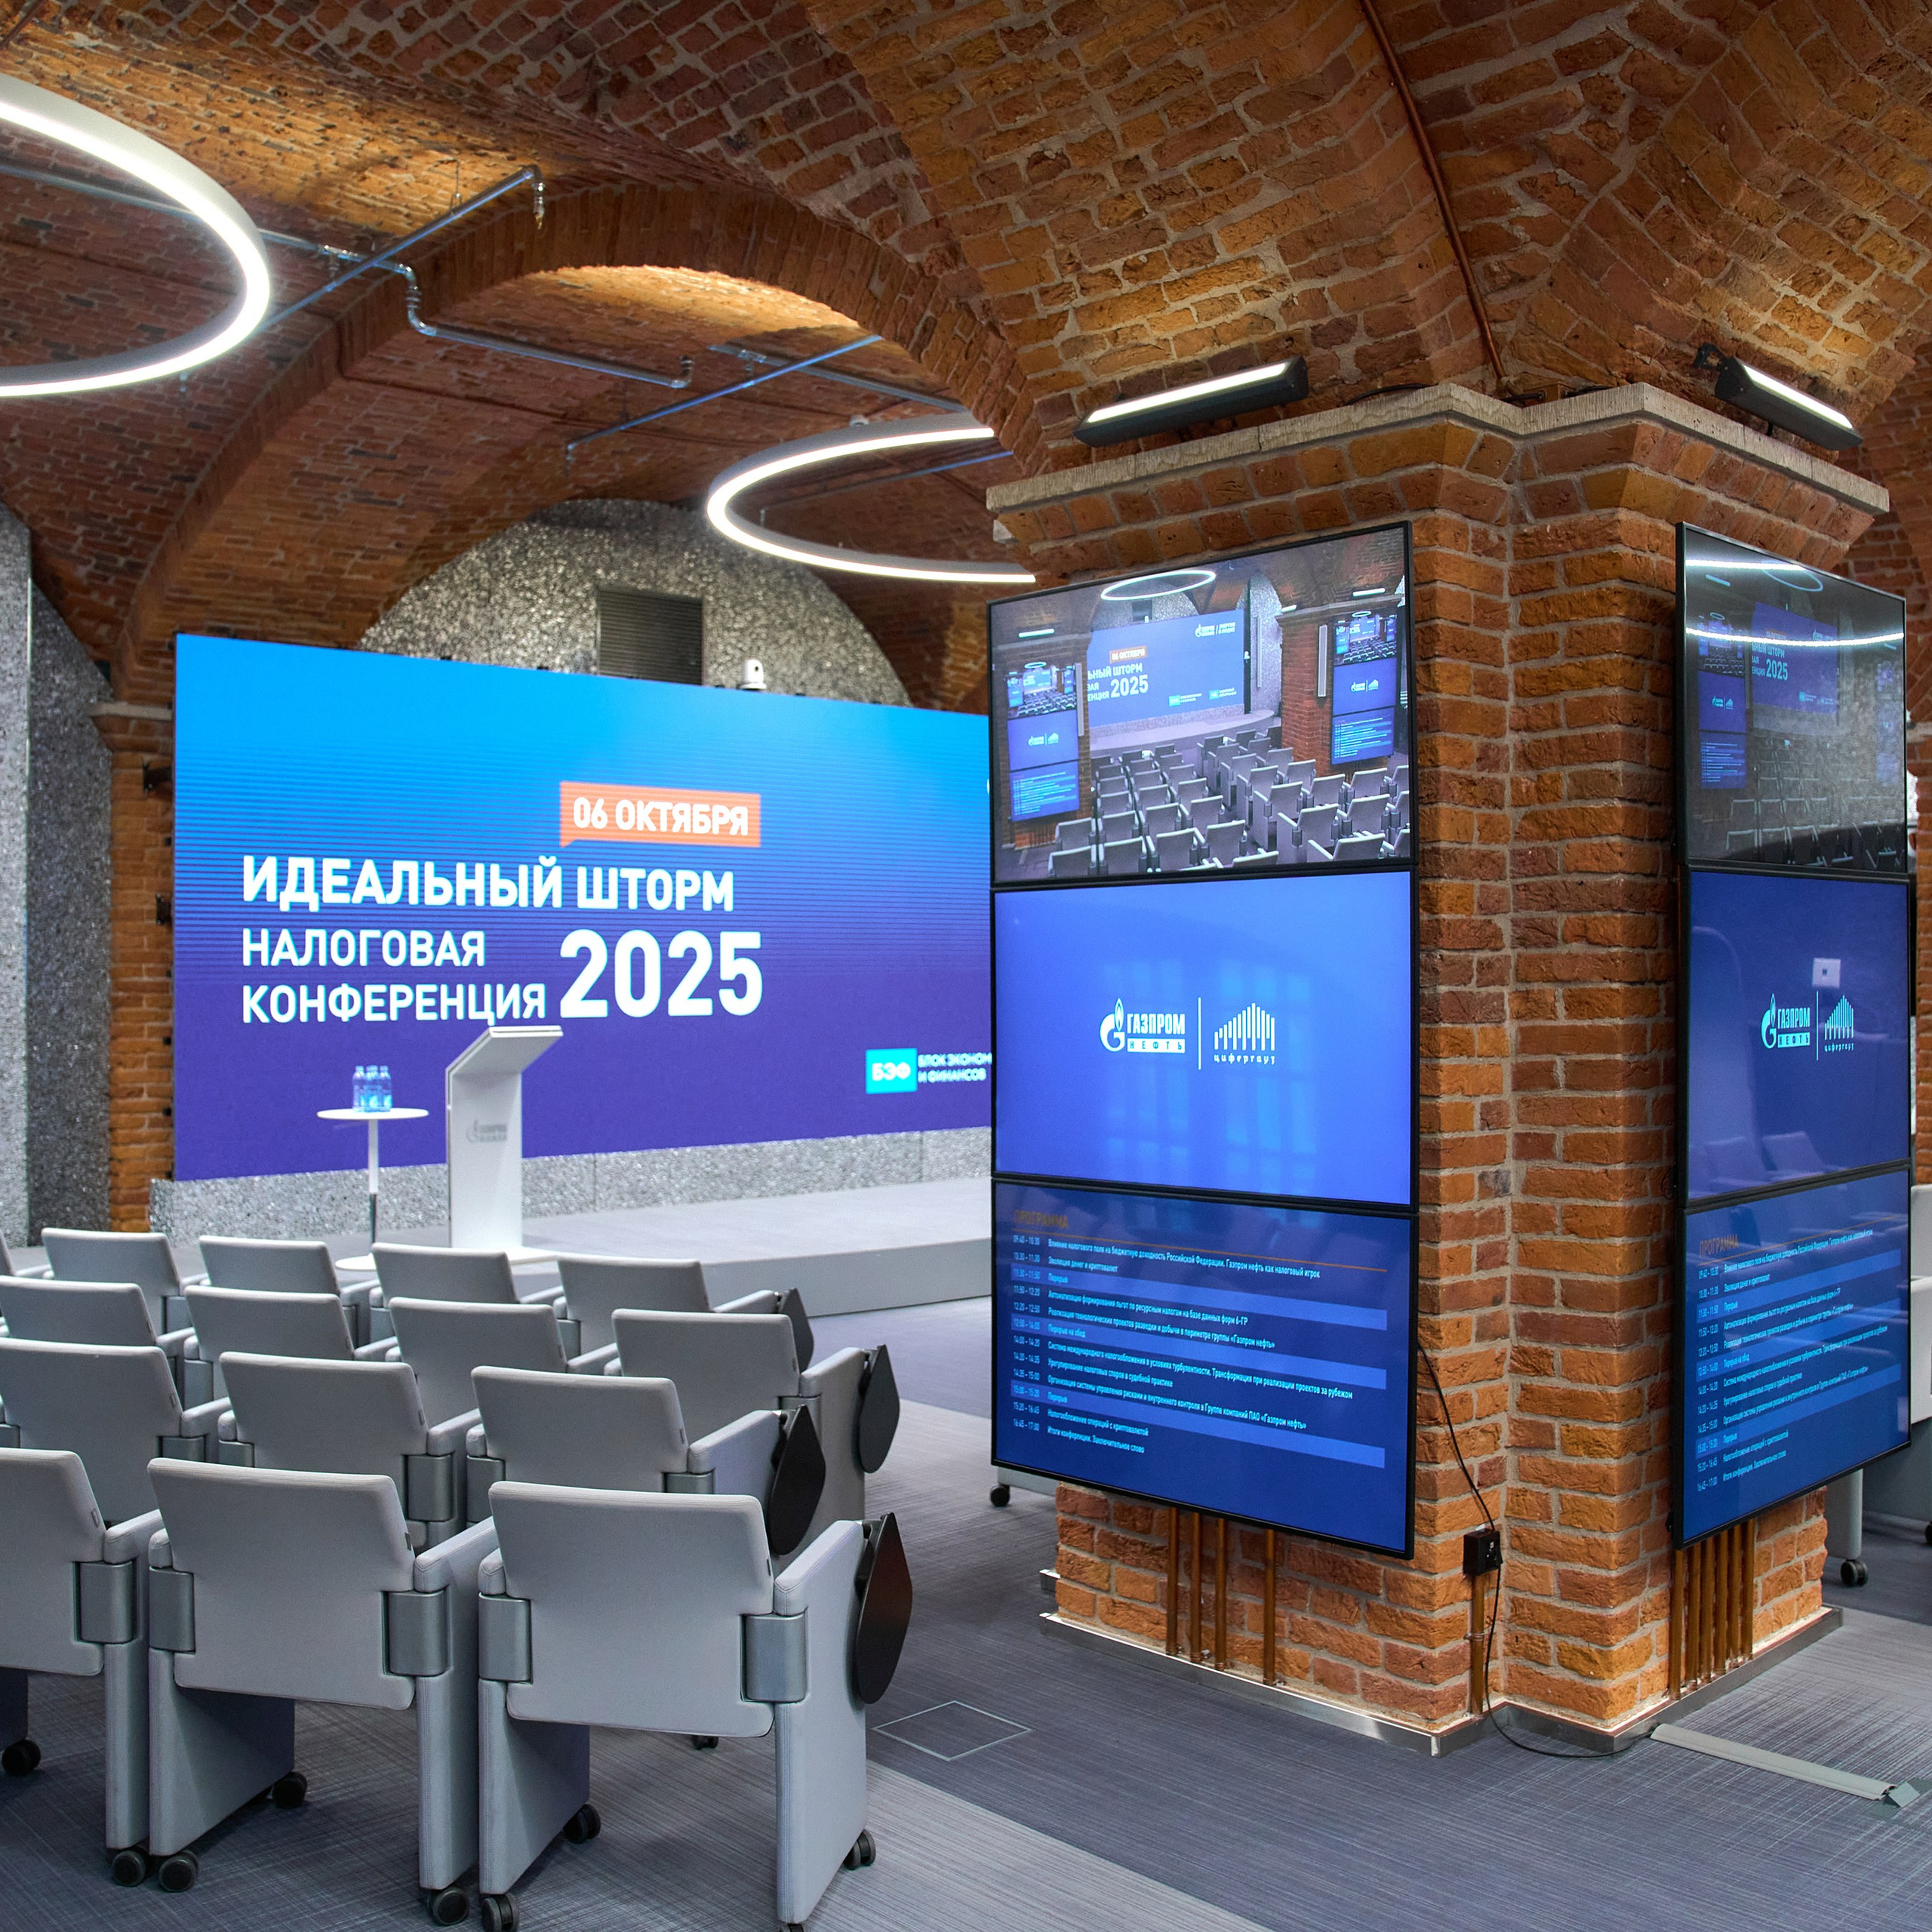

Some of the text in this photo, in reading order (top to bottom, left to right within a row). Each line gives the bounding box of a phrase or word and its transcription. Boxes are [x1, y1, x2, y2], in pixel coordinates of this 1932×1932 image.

[1112, 663, 1143, 677] ШТОРМ
[1766, 658, 1788, 681] 2025
[1110, 674, 1149, 698] 2025
[573, 797, 749, 836] 06 ОКТЯБРЯ
[243, 855, 734, 912] ИДЕАЛЬНЫЙ ШТОРМ
[242, 928, 485, 967] НАЛОГОВАЯ
[560, 928, 763, 1018] 2025
[242, 983, 546, 1026] КОНФЕРЕНЦИЯ
[1127, 1013, 1186, 1035] ГАЗПРОМ
[1777, 1008, 1810, 1029] ГАЗПРОМ
[1130, 1041, 1183, 1050] НЕФТЬ
[1214, 1053, 1275, 1065] цифергауз
[872, 1062, 911, 1081] БЭФ
[1699, 1234, 1739, 1259] ПРОГРАММА
[1111, 1245, 1138, 1257] бюджетную
[1138, 1251, 1165, 1260] доходность
[1166, 1252, 1195, 1263] Российской
[1195, 1255, 1224, 1266] Федерации.
[1226, 1258, 1247, 1270] Газпром
[1247, 1262, 1263, 1272] нефть
[1274, 1266, 1303, 1275] налоговый
[1304, 1269, 1319, 1278] игрок
[1135, 1303, 1161, 1313] ресурсным
[1189, 1309, 1201, 1319] базе
[1201, 1312, 1220, 1321] данных
[1221, 1314, 1235, 1324] форм
[1235, 1315, 1247, 1324] 6-ГР
[1112, 1318, 1134, 1327] проектов
[1134, 1321, 1157, 1331] разведки
[1161, 1324, 1180, 1334] добычи
[1184, 1329, 1211, 1340] периметре
[1211, 1333, 1229, 1342] группы
[1230, 1334, 1255, 1346] «Газпром
[1255, 1338, 1275, 1349] нефть»
[1104, 1352, 1146, 1364] налогообложения
[1149, 1360, 1171, 1368] условиях
[1172, 1362, 1211, 1375] турбулентности.
[1212, 1367, 1251, 1382] Трансформация
[1252, 1376, 1263, 1385] при
[1263, 1378, 1294, 1389] реализации
[1295, 1383, 1320, 1393] проектов
[1327, 1387, 1352, 1398] рубежом
[1108, 1370, 1124, 1379] споров
[1128, 1373, 1150, 1383] судебной
[1150, 1377, 1173, 1387] практике
[1122, 1390, 1143, 1399] рисками
[1147, 1394, 1177, 1405] внутреннего
[1177, 1400, 1200, 1410] контроля
[1204, 1402, 1222, 1414] Группе
[1223, 1408, 1247, 1418] компаний
[1248, 1411, 1260, 1420] ПАО
[1260, 1413, 1286, 1426] «Газпром
[1287, 1419, 1306, 1429] нефть»
[1112, 1423, 1148, 1435] криптовалютой
[1130, 1444, 1144, 1453] слово
